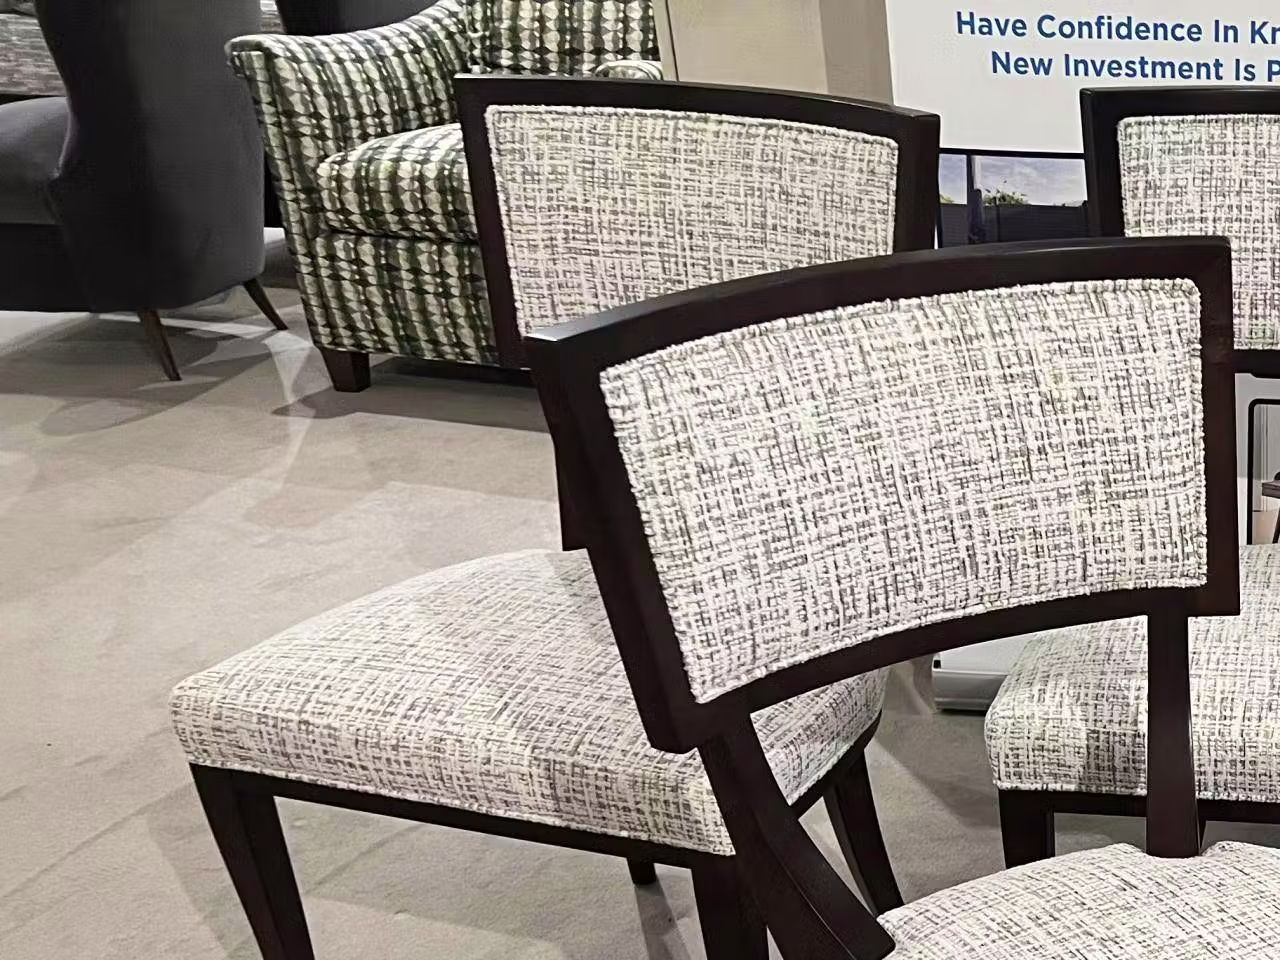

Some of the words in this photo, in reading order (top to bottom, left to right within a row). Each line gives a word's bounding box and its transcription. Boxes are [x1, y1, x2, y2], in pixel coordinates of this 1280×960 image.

[956, 11, 1028, 37] Have
[1037, 15, 1202, 42] Confidence
[1214, 20, 1239, 43] In
[991, 51, 1053, 75] New
[1064, 54, 1224, 80] Investment
[1235, 58, 1256, 82] Is
